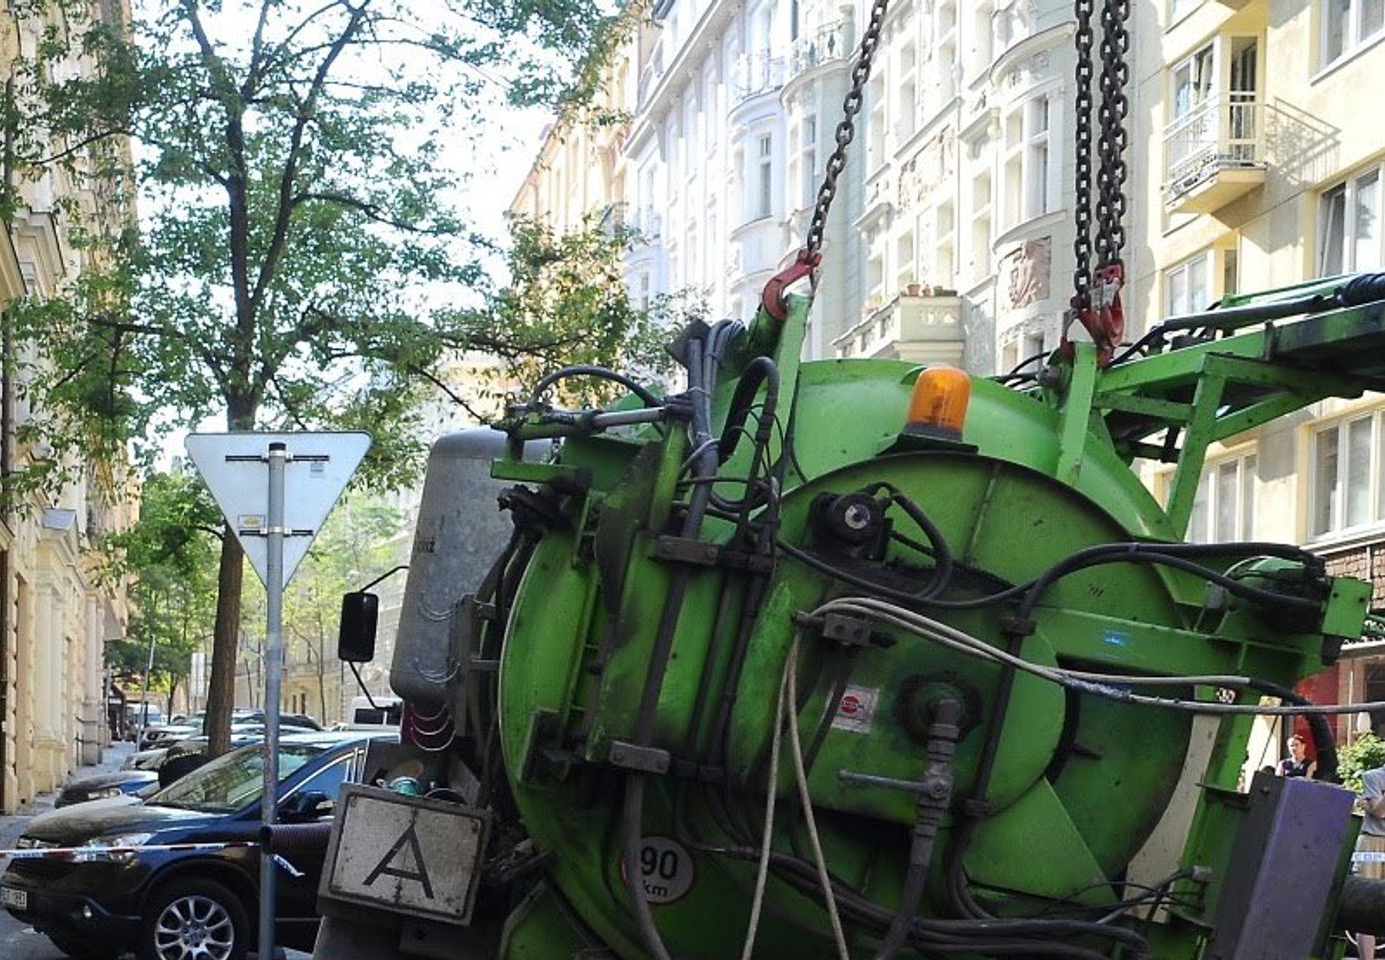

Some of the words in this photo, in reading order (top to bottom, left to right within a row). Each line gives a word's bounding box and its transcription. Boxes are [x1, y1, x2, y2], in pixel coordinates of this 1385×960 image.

[362, 820, 435, 899] A
[641, 845, 679, 880] 90
[643, 879, 668, 897] km
